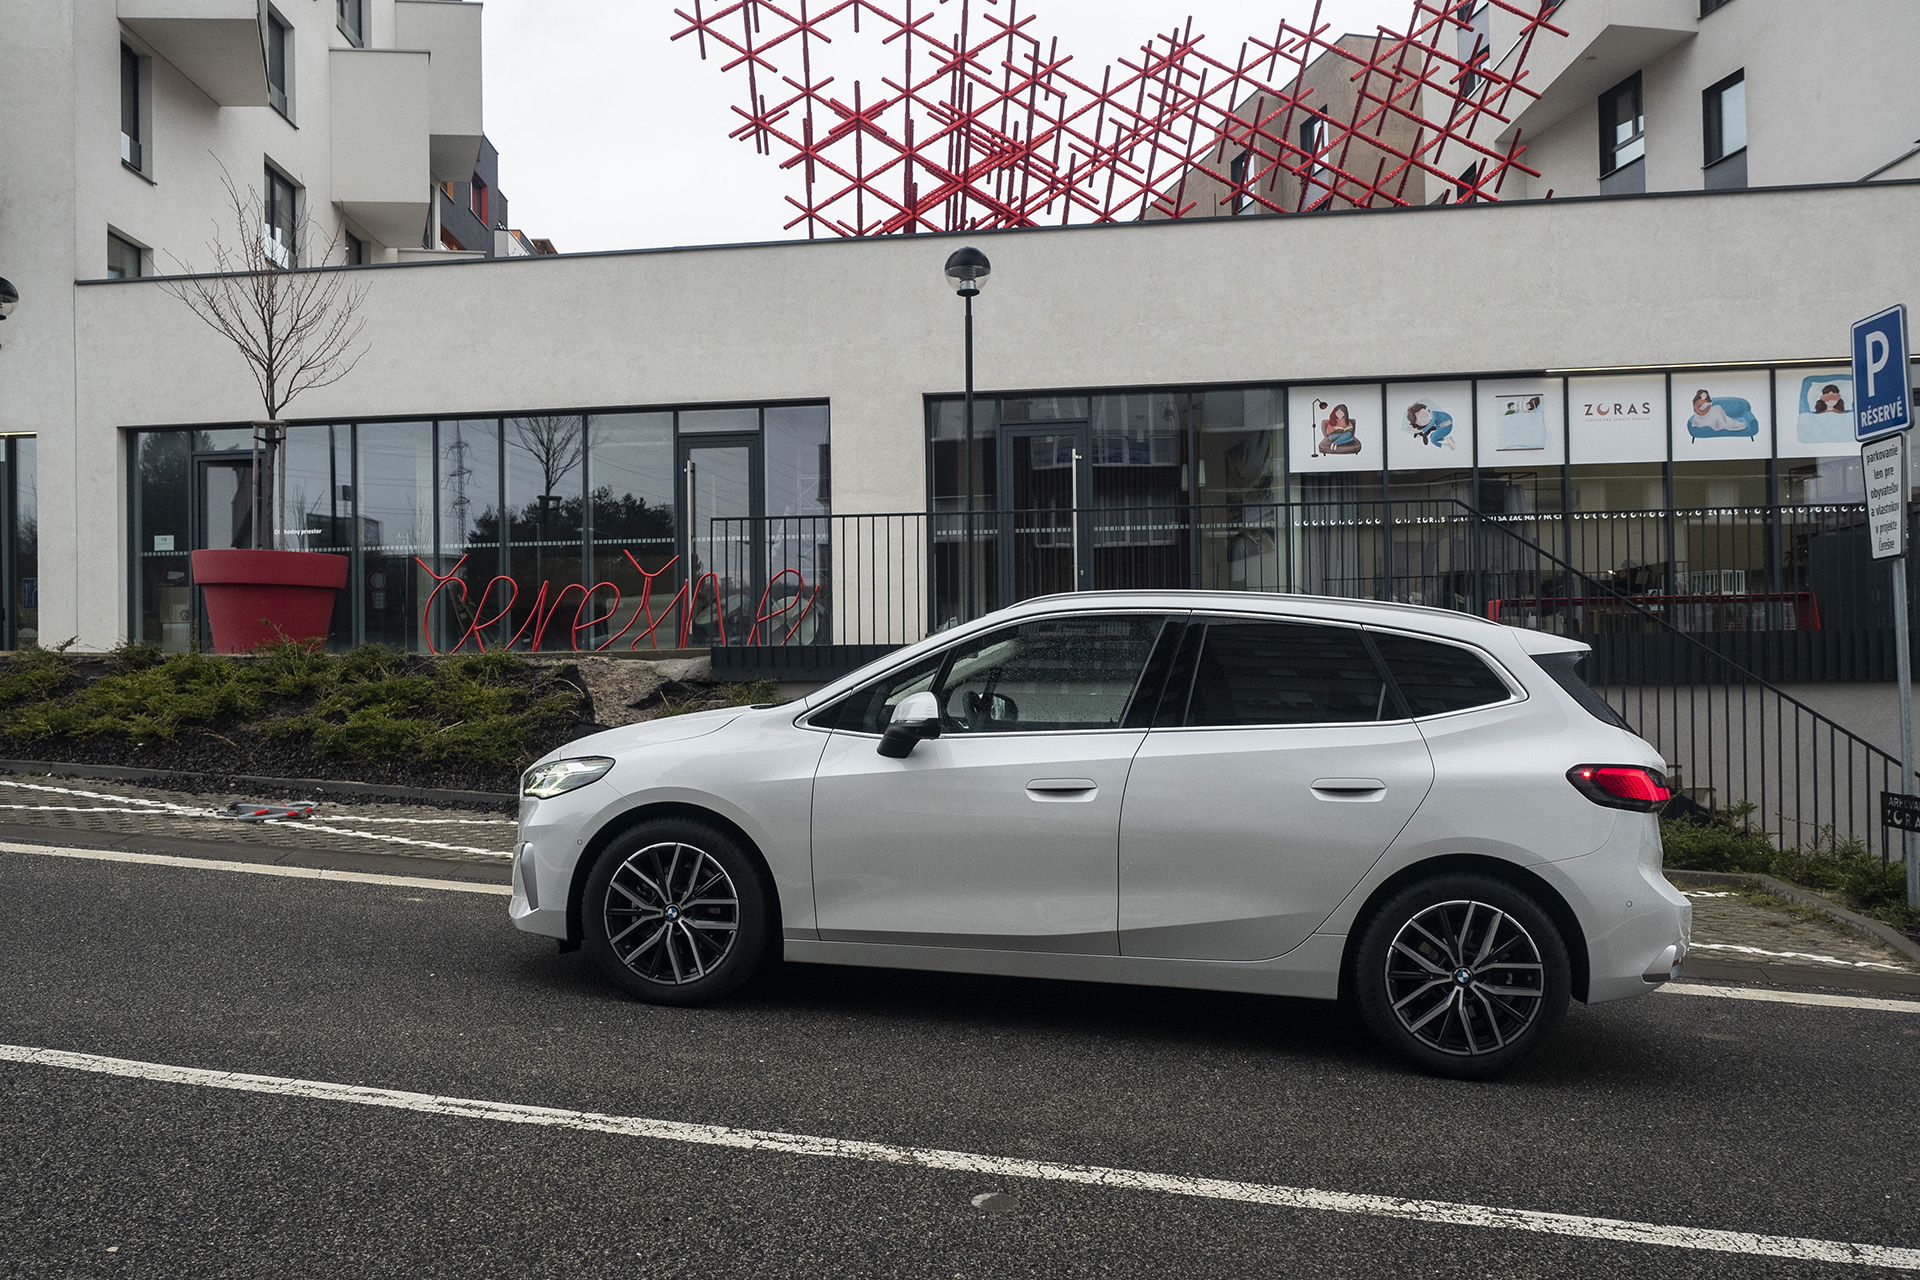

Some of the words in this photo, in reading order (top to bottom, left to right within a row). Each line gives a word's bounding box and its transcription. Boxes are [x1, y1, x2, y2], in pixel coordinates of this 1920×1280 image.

[1865, 330, 1889, 398] P
[1584, 402, 1651, 416] ZORAS
[1861, 396, 1903, 428] RÉSERVÉ
[1867, 444, 1898, 466] parkovanie
[1873, 469, 1884, 480] len
[1884, 466, 1894, 480] pre
[1871, 508, 1875, 517] a
[1416, 516, 1446, 524] ZORS
[1875, 525, 1879, 534] v
[1880, 520, 1897, 535] projekte
